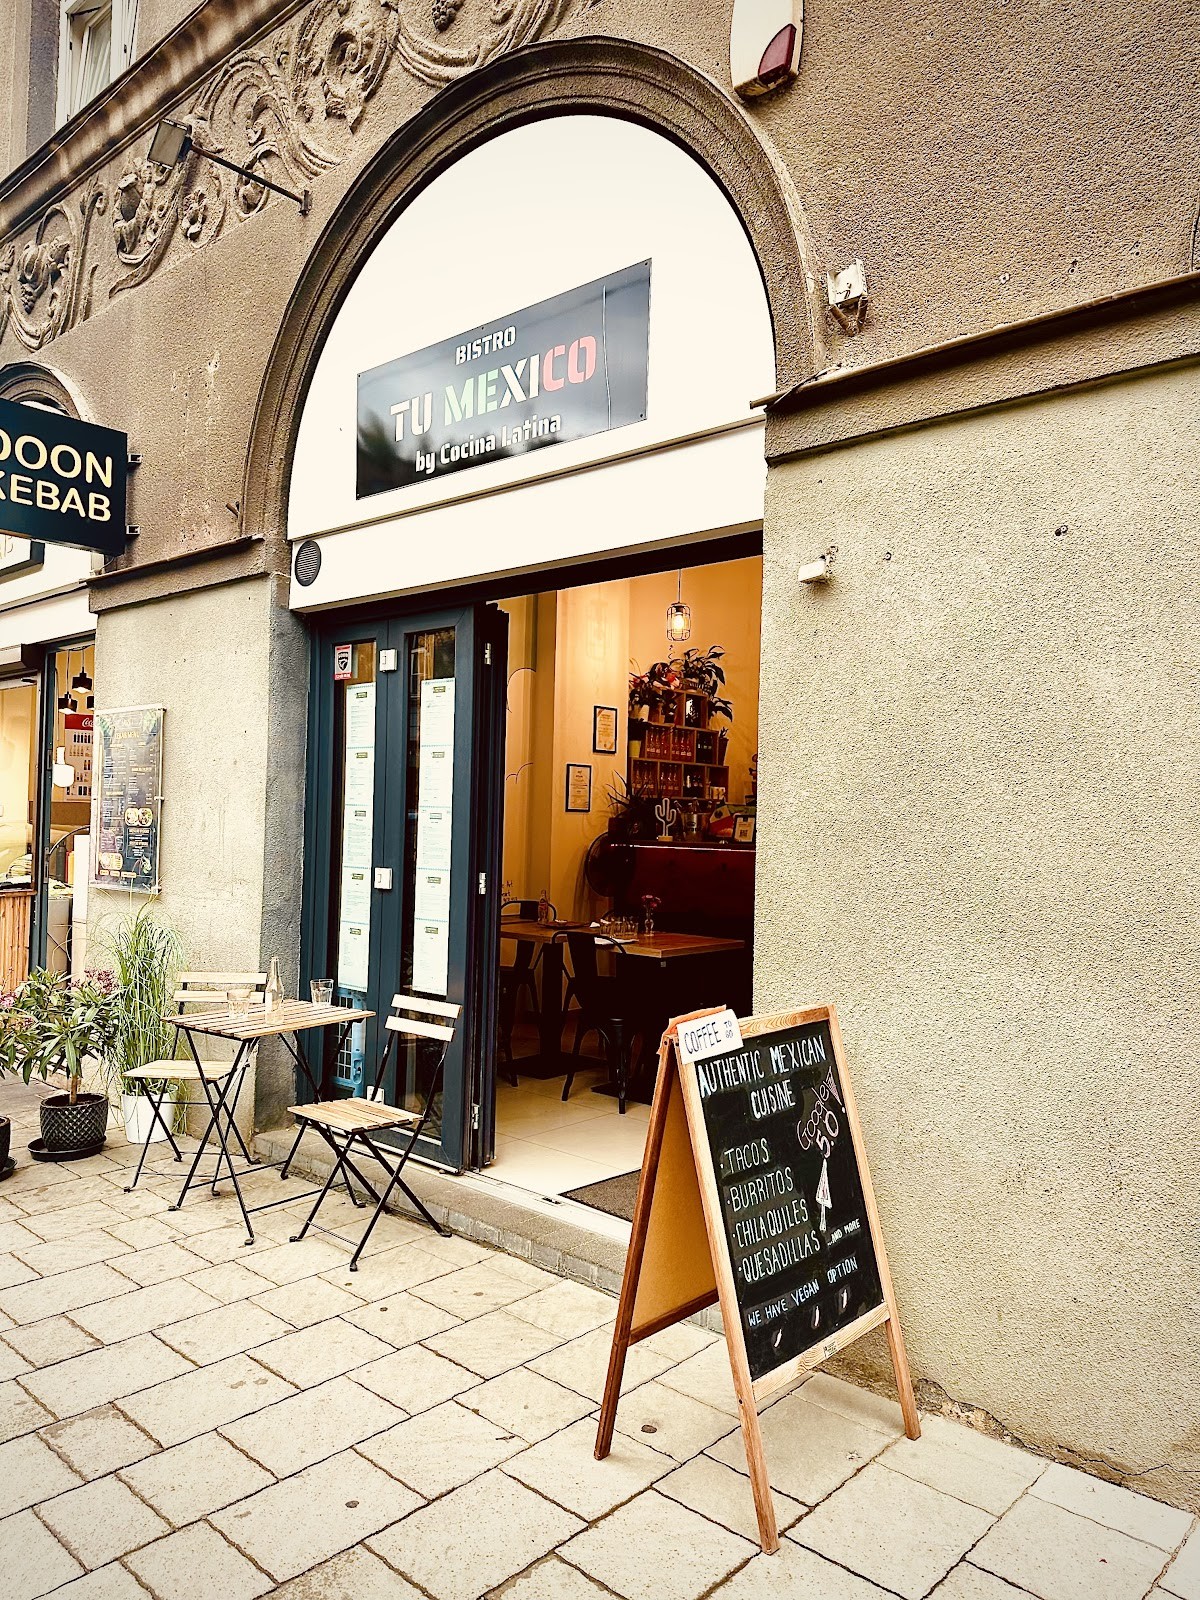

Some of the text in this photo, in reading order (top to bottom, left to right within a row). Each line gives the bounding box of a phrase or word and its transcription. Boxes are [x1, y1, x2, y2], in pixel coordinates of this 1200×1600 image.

[455, 326, 516, 366] BISTRO
[390, 335, 597, 442] TU MEXICO
[415, 413, 562, 474] by Cocina Latina
[0, 470, 112, 522] EBAB
[684, 1020, 733, 1054] COFFEE TO
[697, 1035, 827, 1098] AUTHENTIC MEXICAN
[750, 1079, 796, 1119] CUISINE
[797, 1084, 829, 1151] Google
[725, 1138, 770, 1173] TACOS
[730, 1167, 793, 1212] BURRITOS
[735, 1198, 809, 1248] CHILAQUILES
[843, 1218, 861, 1234] MORE
[742, 1230, 821, 1283] QUESADILLAS
[748, 1256, 858, 1327] WE HAVE VEGAN OPTION
